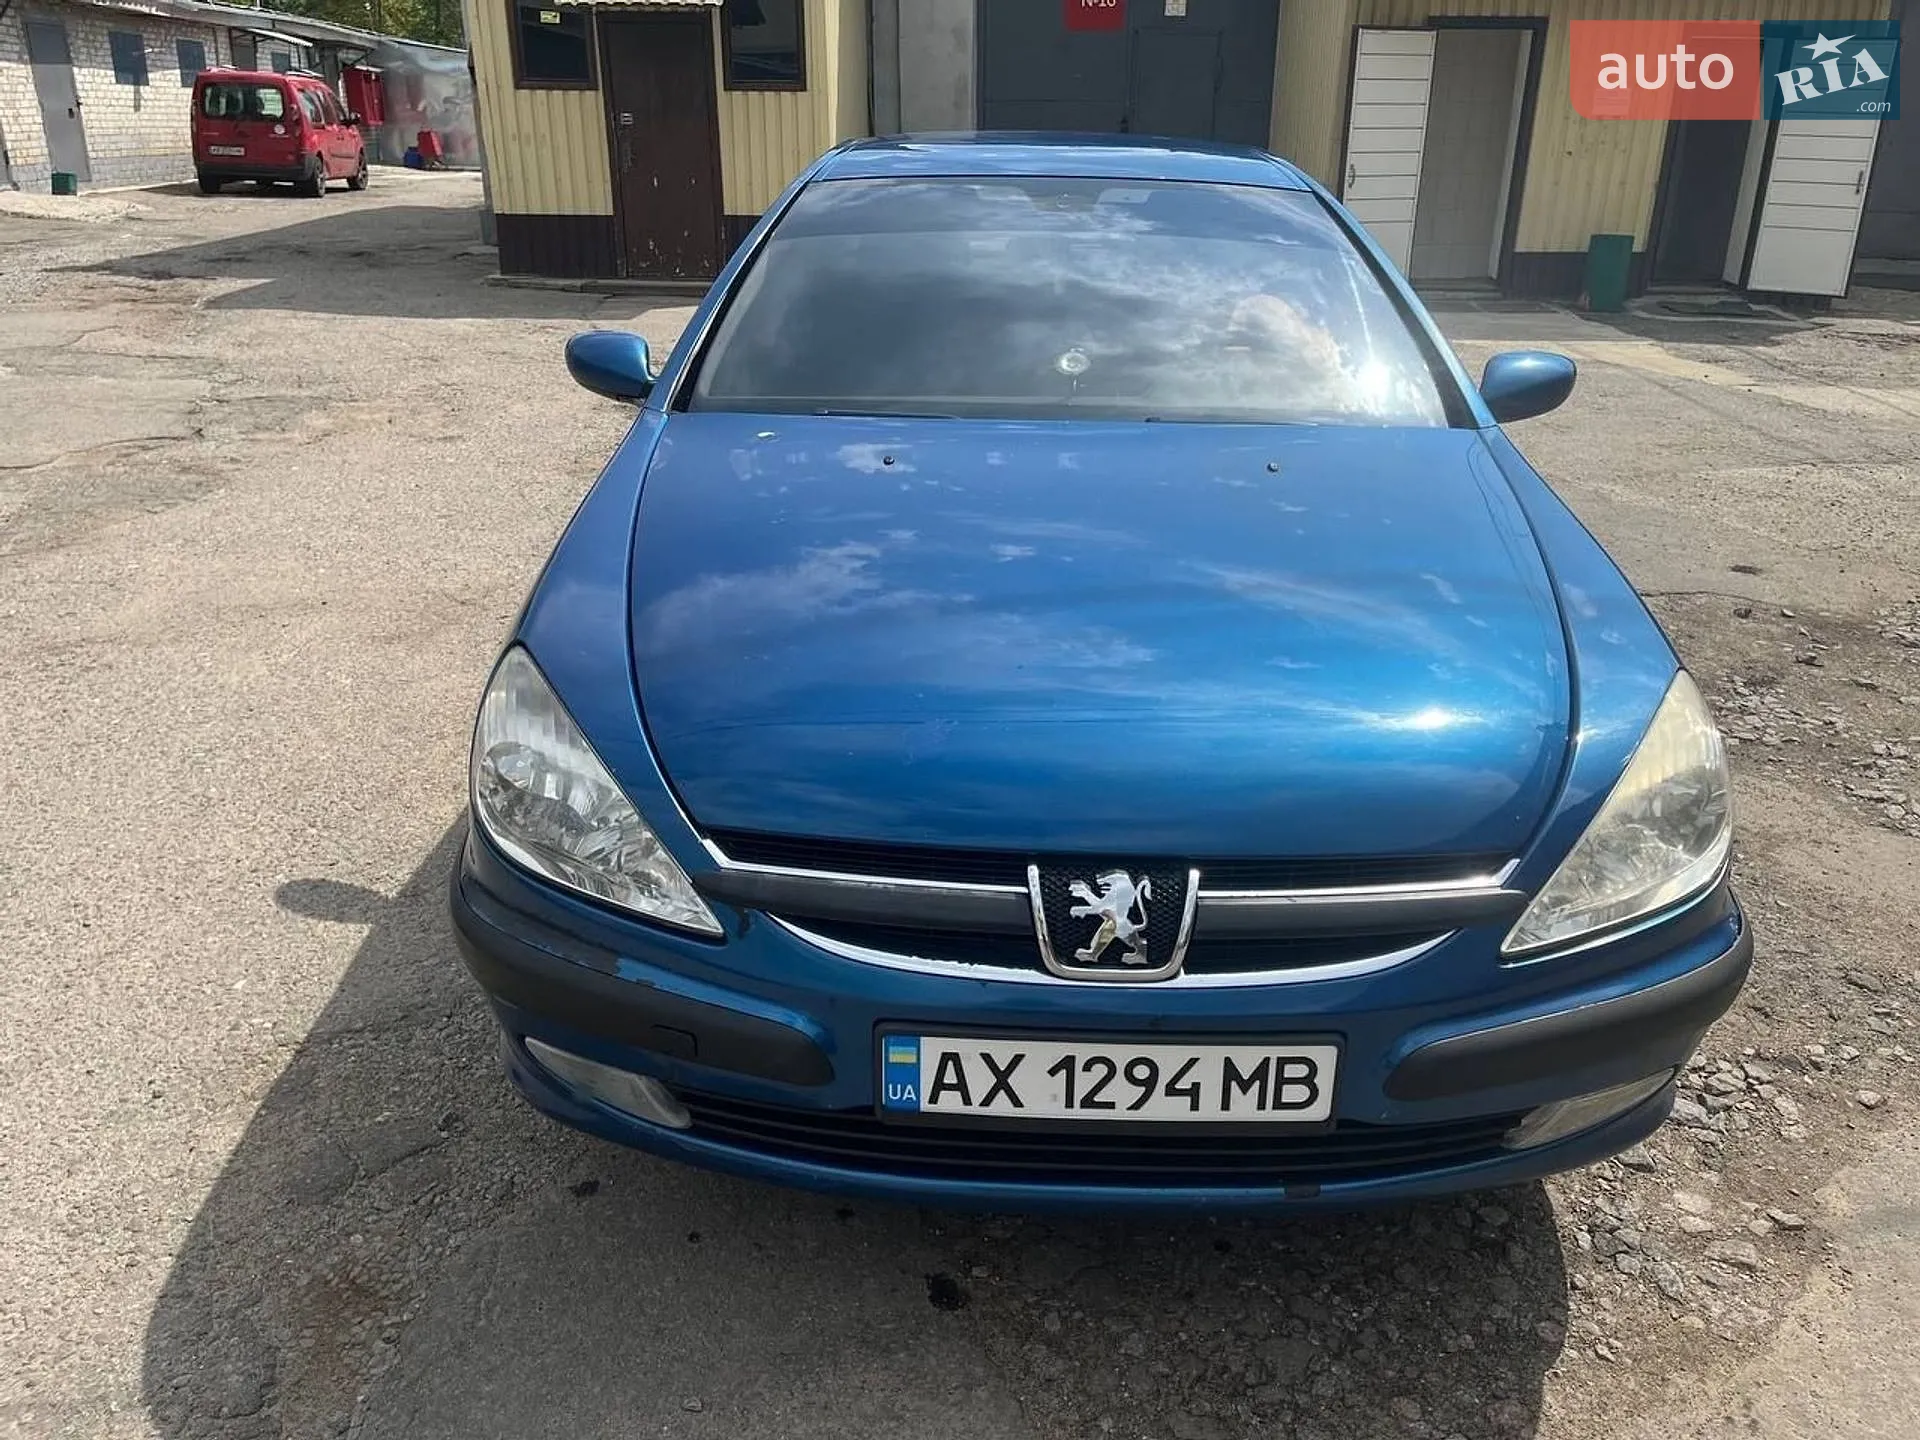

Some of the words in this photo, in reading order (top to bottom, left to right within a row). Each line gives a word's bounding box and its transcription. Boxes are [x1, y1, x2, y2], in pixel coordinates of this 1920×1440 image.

[888, 1084, 917, 1101] UA
[927, 1051, 1026, 1108] AX
[1047, 1055, 1201, 1112] 1294
[1220, 1056, 1319, 1111] MB
